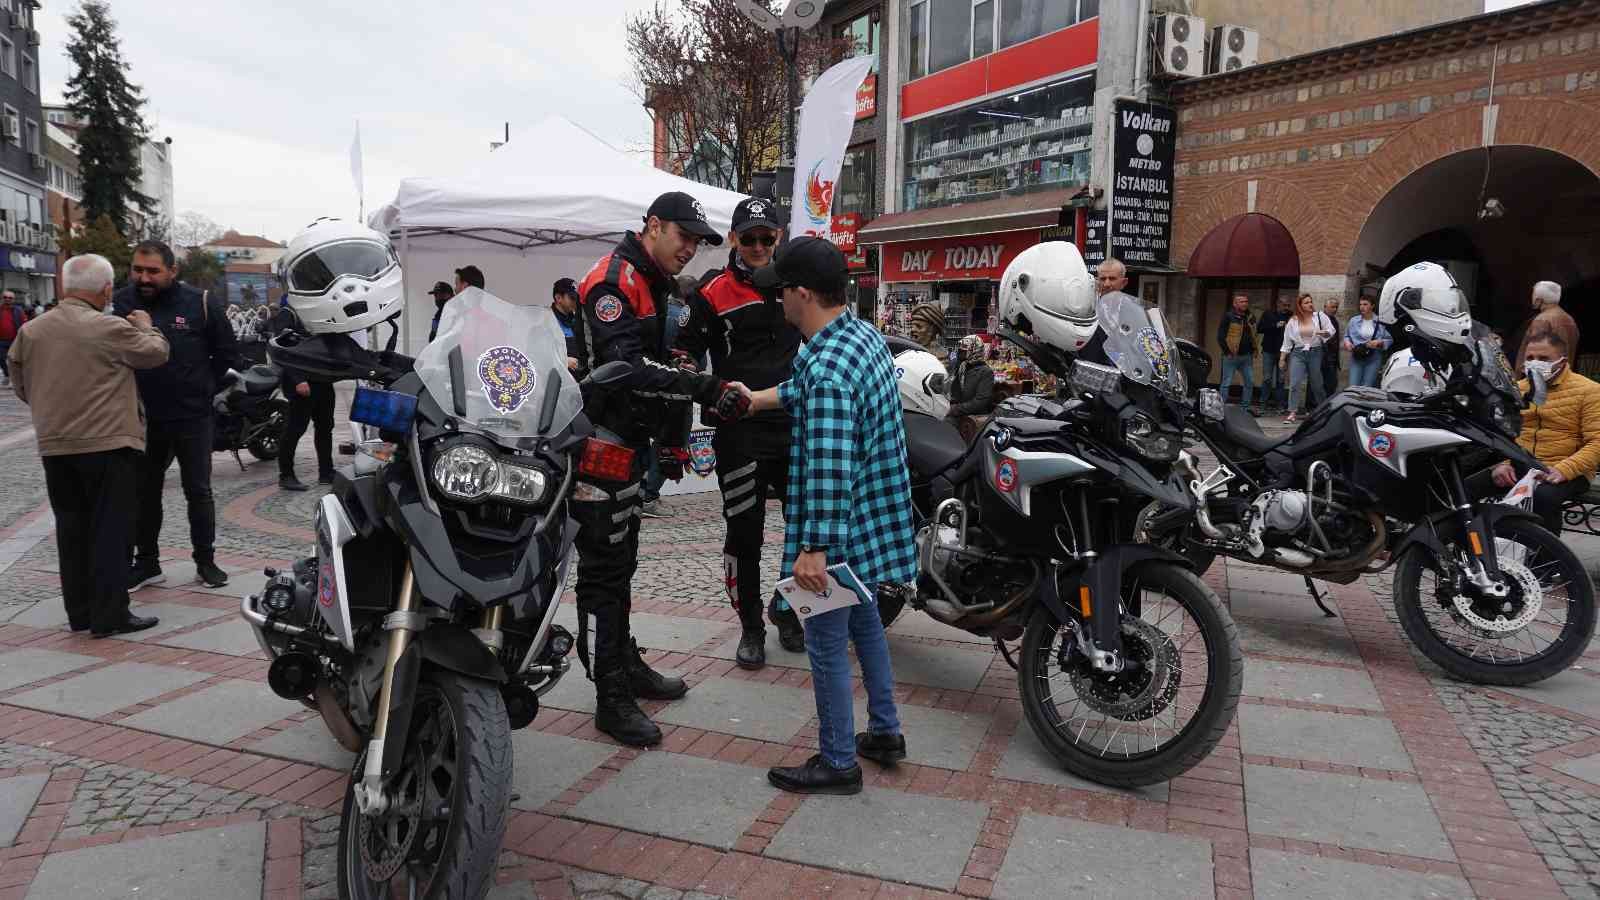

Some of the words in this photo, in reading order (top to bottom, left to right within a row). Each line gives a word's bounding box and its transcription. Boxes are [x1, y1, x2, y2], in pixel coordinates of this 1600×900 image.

[1122, 110, 1171, 133] Volkan
[1128, 157, 1162, 171] METRO
[1116, 171, 1169, 194] İSTANBUL
[901, 250, 935, 272] DAY
[944, 245, 1006, 270] TODAY
